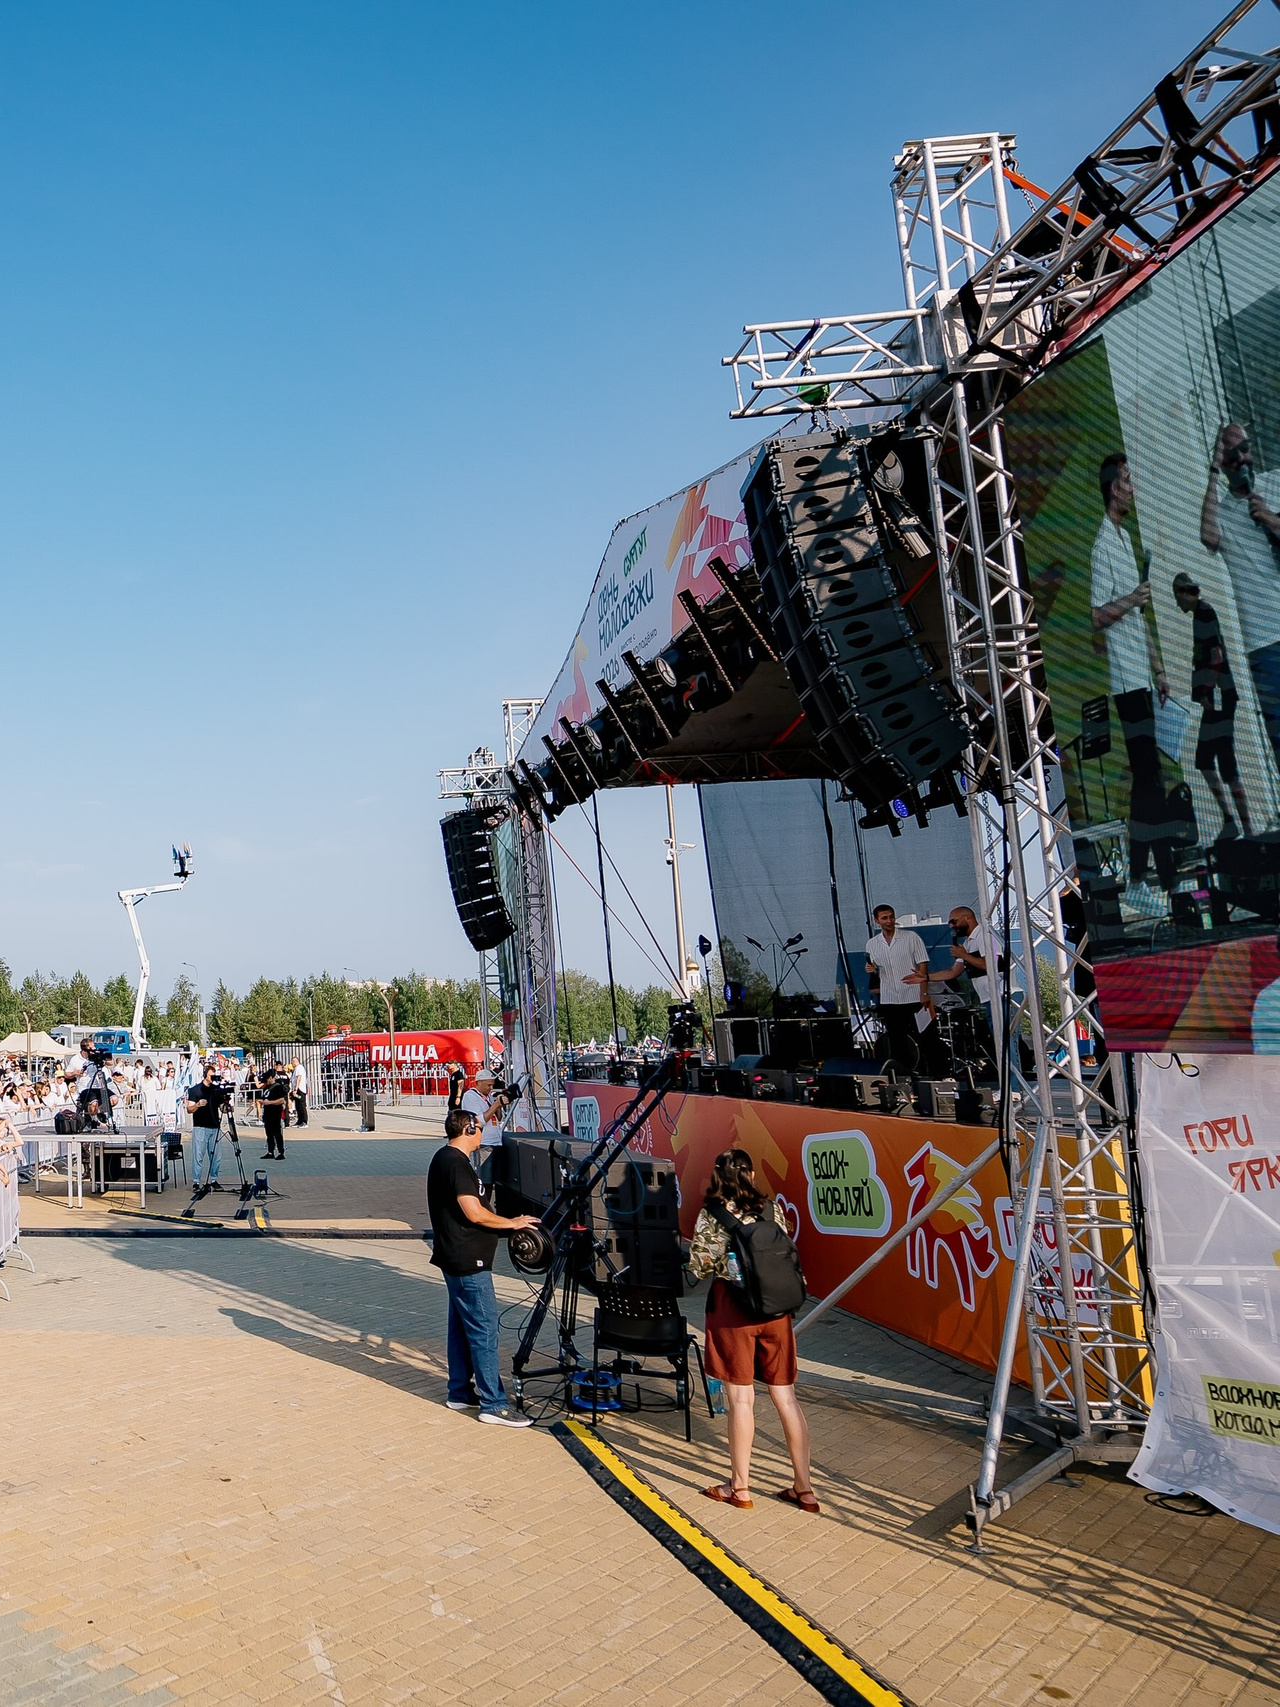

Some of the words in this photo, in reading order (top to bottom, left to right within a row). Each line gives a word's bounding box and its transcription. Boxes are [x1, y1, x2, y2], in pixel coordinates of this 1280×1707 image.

[371, 1044, 439, 1063] ПИЦЦА
[1183, 1114, 1255, 1155] ГОРИ
[811, 1150, 849, 1179] ВДОХ-
[816, 1178, 874, 1217] НОВЛЯЙ
